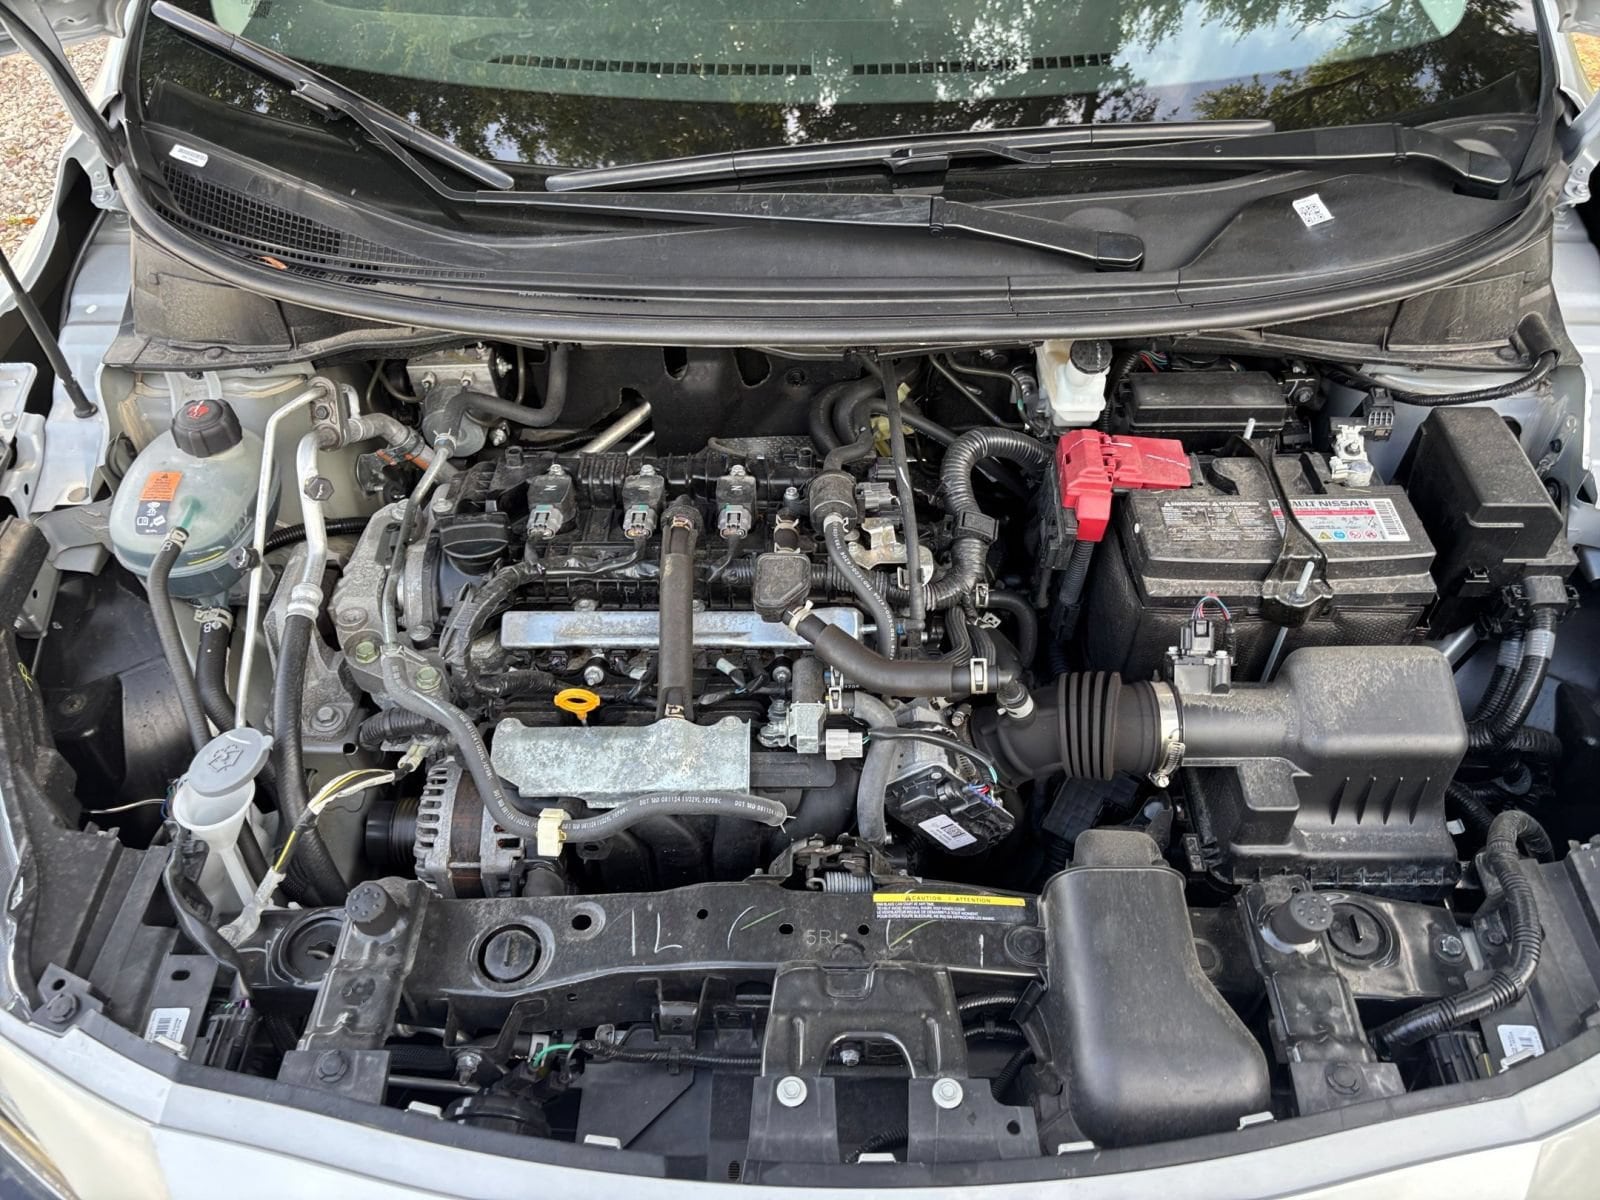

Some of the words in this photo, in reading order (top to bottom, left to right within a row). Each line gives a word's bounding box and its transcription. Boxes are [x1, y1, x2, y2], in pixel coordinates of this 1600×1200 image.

[1272, 500, 1317, 508] RAULT
[1319, 500, 1369, 508] NISSAN
[955, 896, 991, 904] ATTENTION
